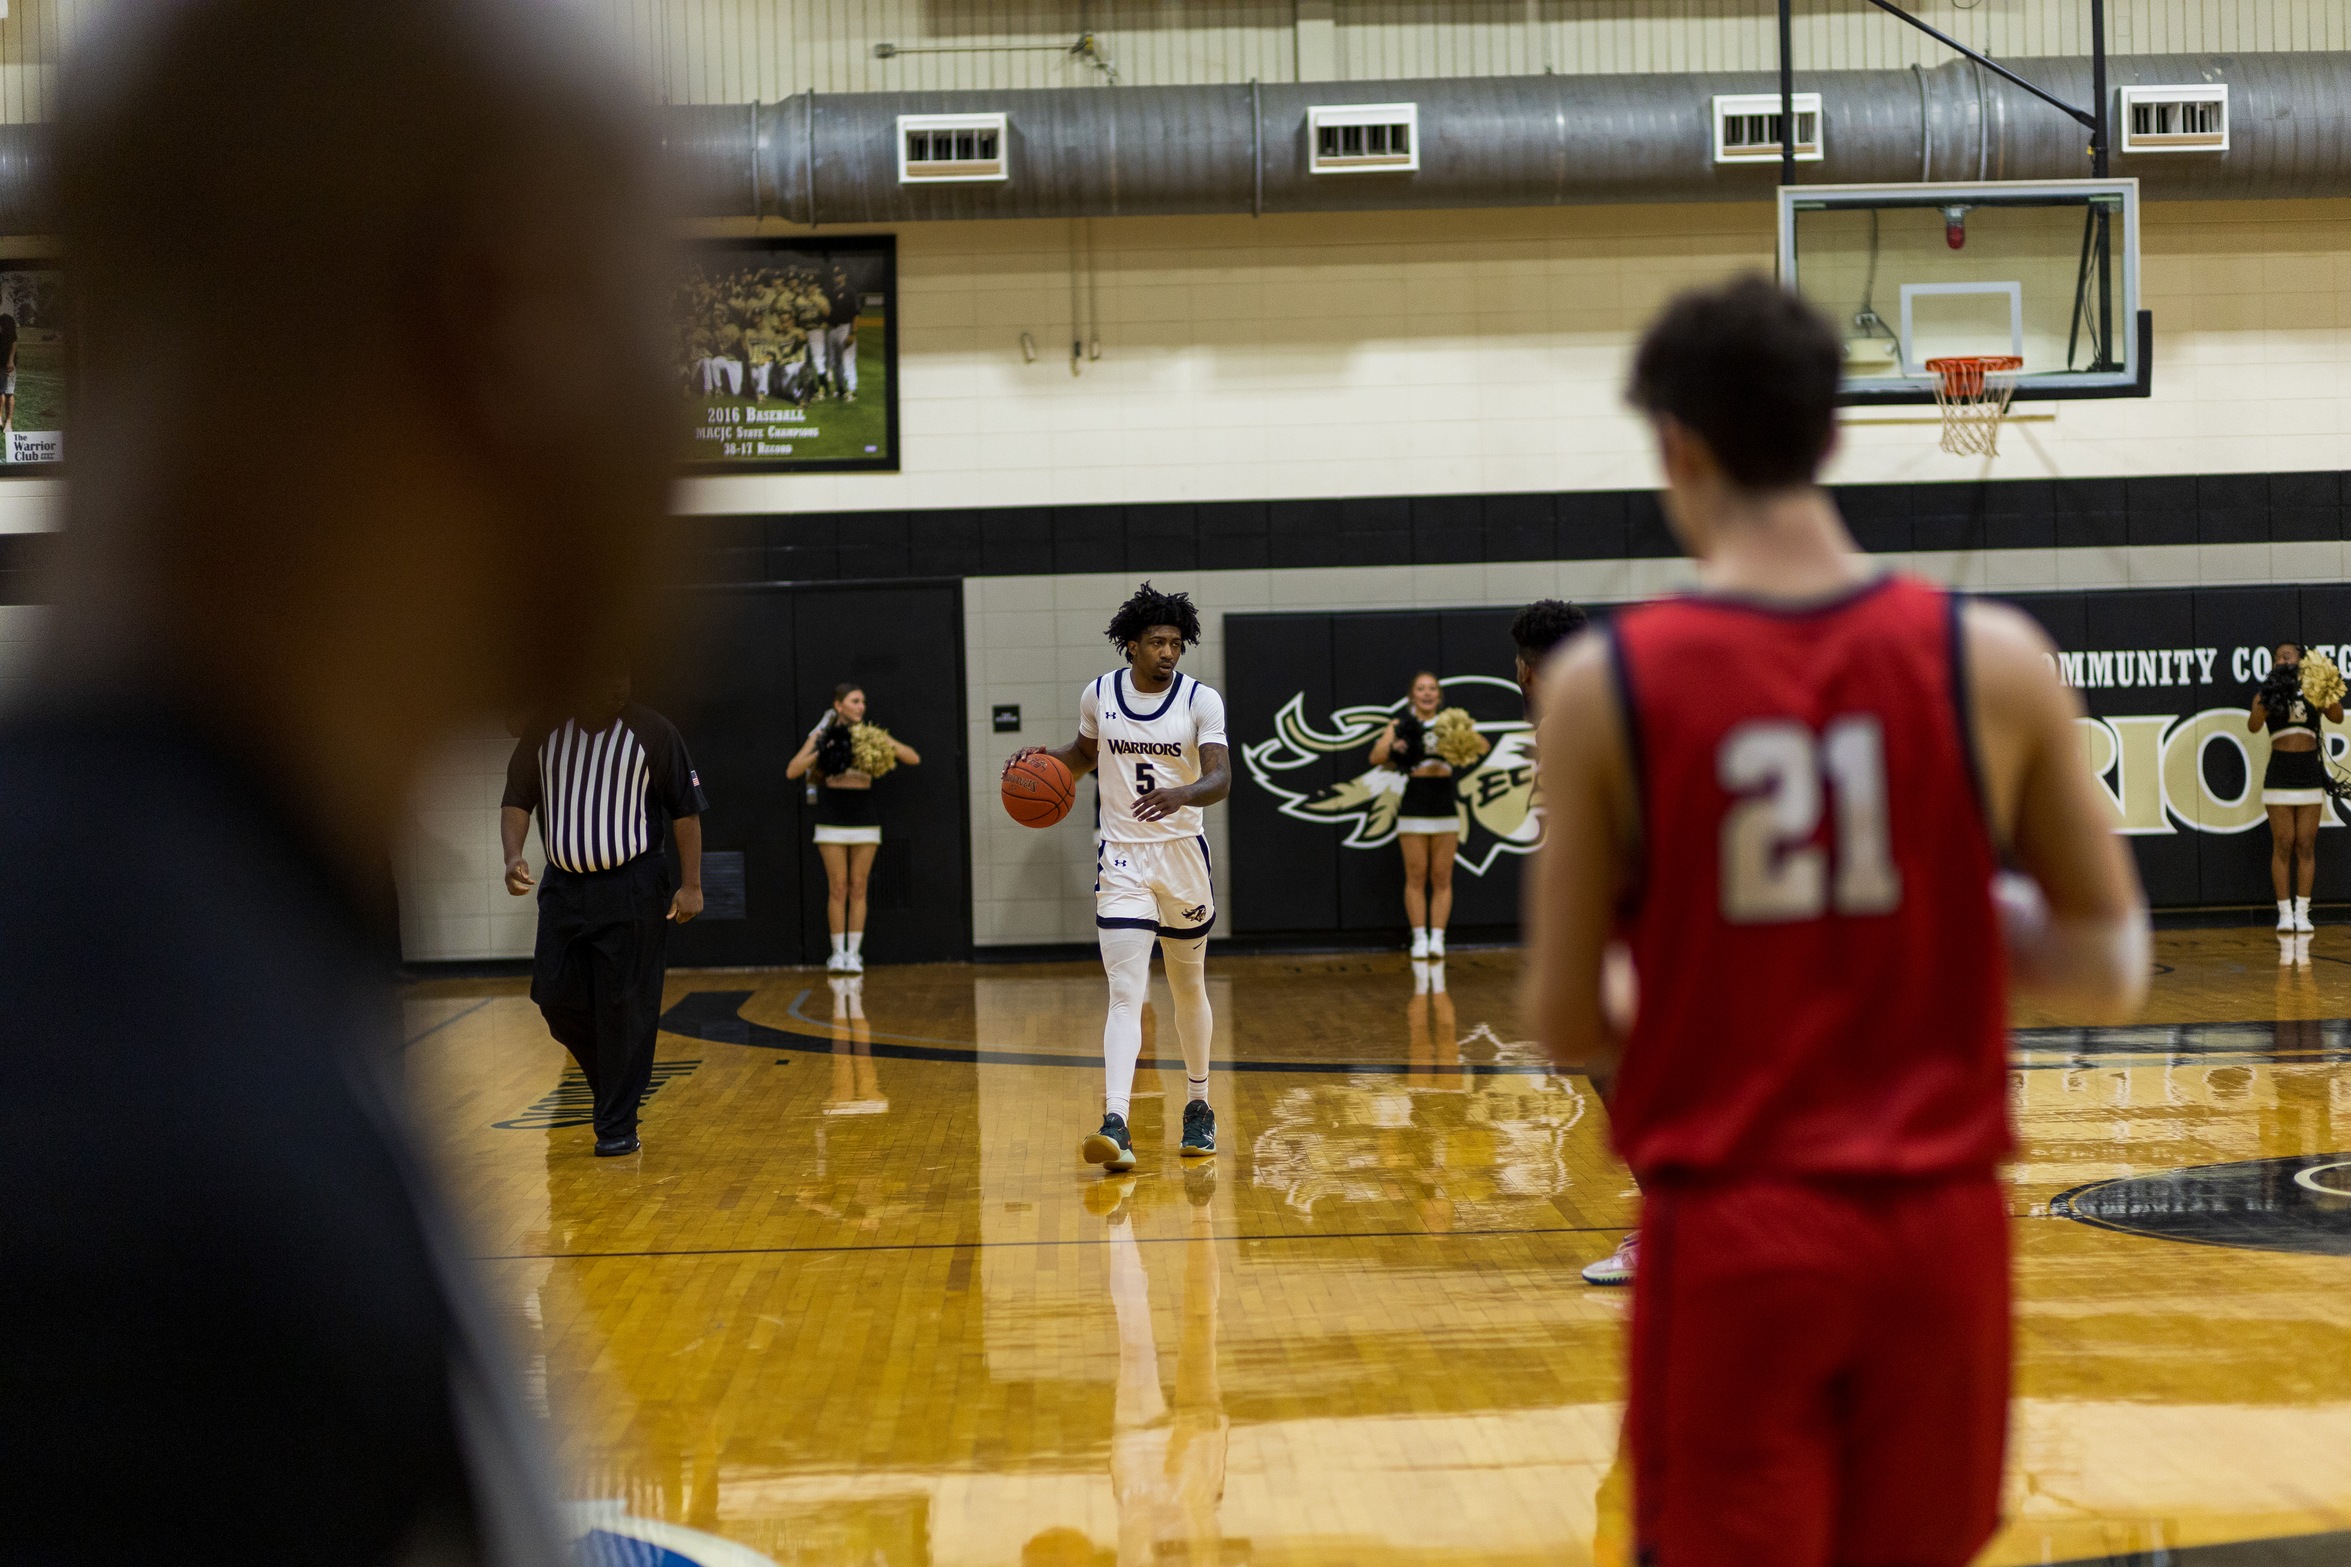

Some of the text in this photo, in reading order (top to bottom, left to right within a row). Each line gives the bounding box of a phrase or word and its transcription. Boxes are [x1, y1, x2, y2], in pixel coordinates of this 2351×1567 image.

[707, 406, 740, 423] 2016
[14, 440, 56, 451] Warrior
[14, 451, 39, 461] Club
[1107, 738, 1182, 757] WARRIORS
[1135, 762, 1156, 796] 5
[1716, 716, 1902, 924] 21
